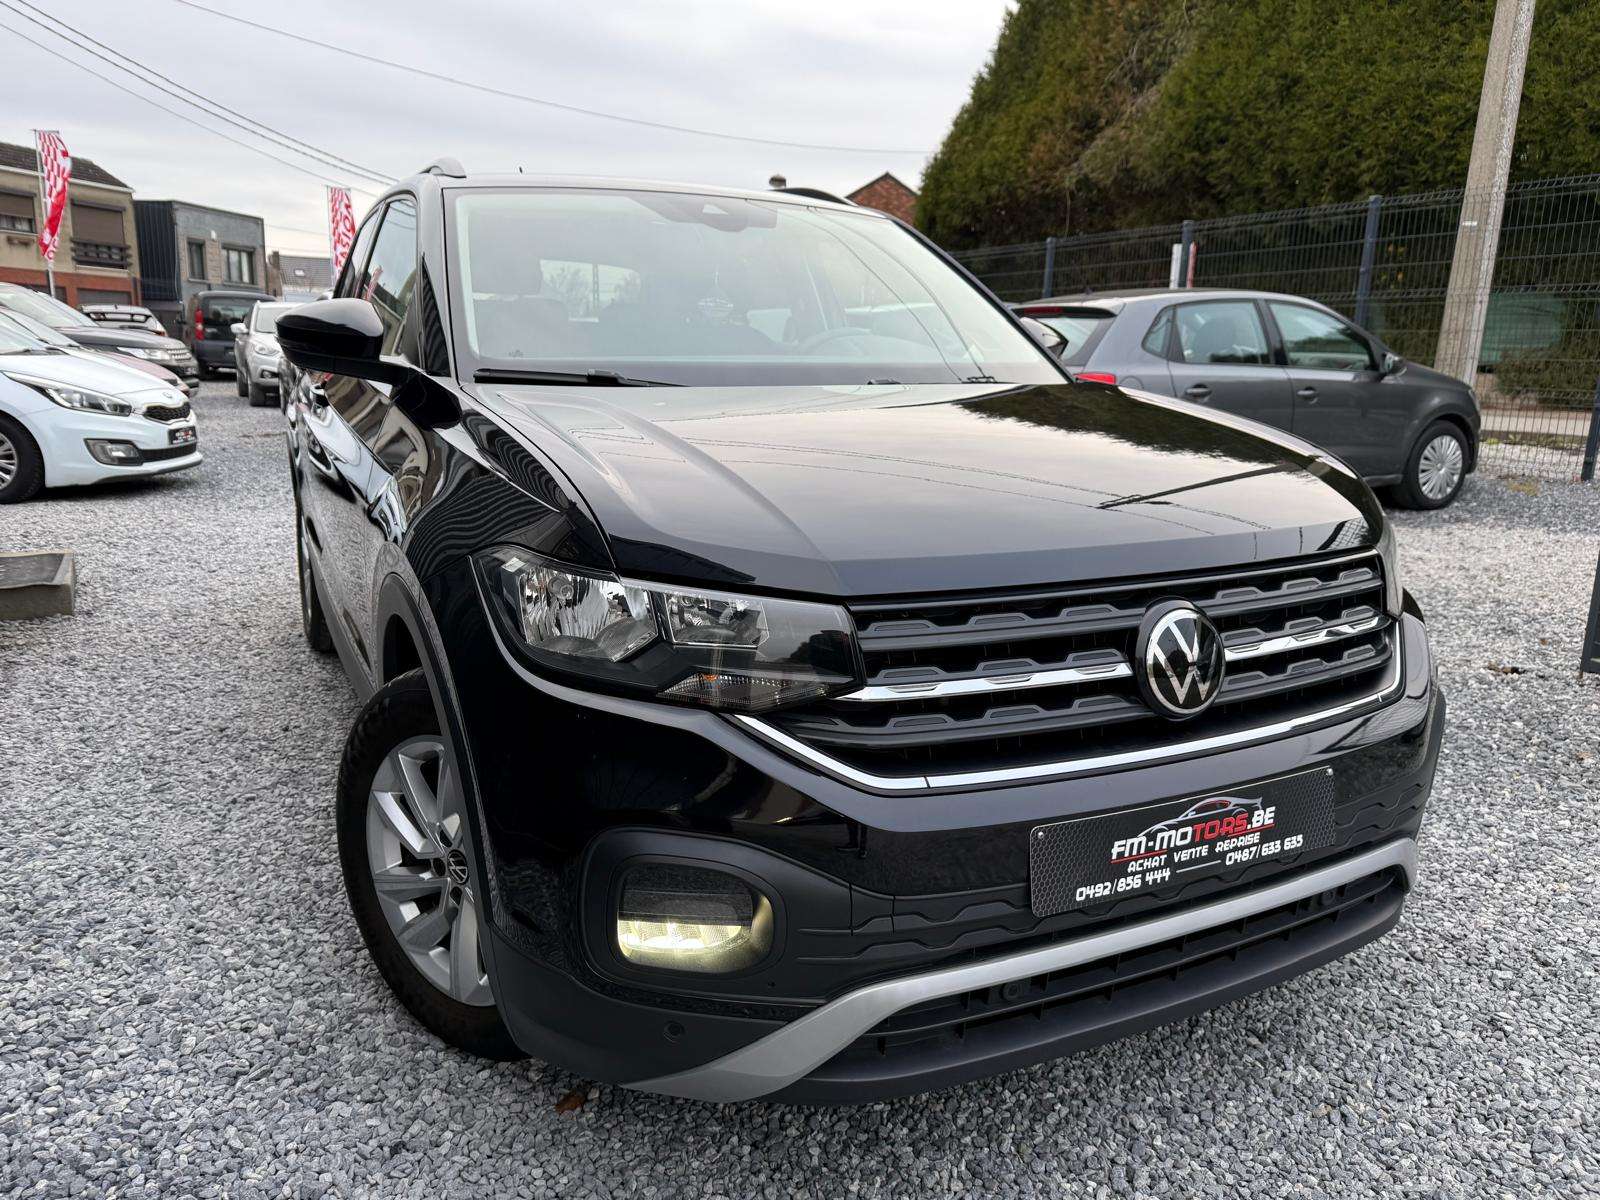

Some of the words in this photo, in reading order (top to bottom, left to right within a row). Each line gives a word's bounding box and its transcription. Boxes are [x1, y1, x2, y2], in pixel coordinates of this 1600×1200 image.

[1110, 806, 1276, 860] FM-MOTORS.BE
[1127, 854, 1167, 873] ACHAT
[1174, 846, 1208, 862] VENTE
[1215, 832, 1260, 853] REPRISE
[1225, 839, 1281, 866] 0487/633
[1075, 874, 1141, 902] 0492/856
[1146, 867, 1171, 885] 444
